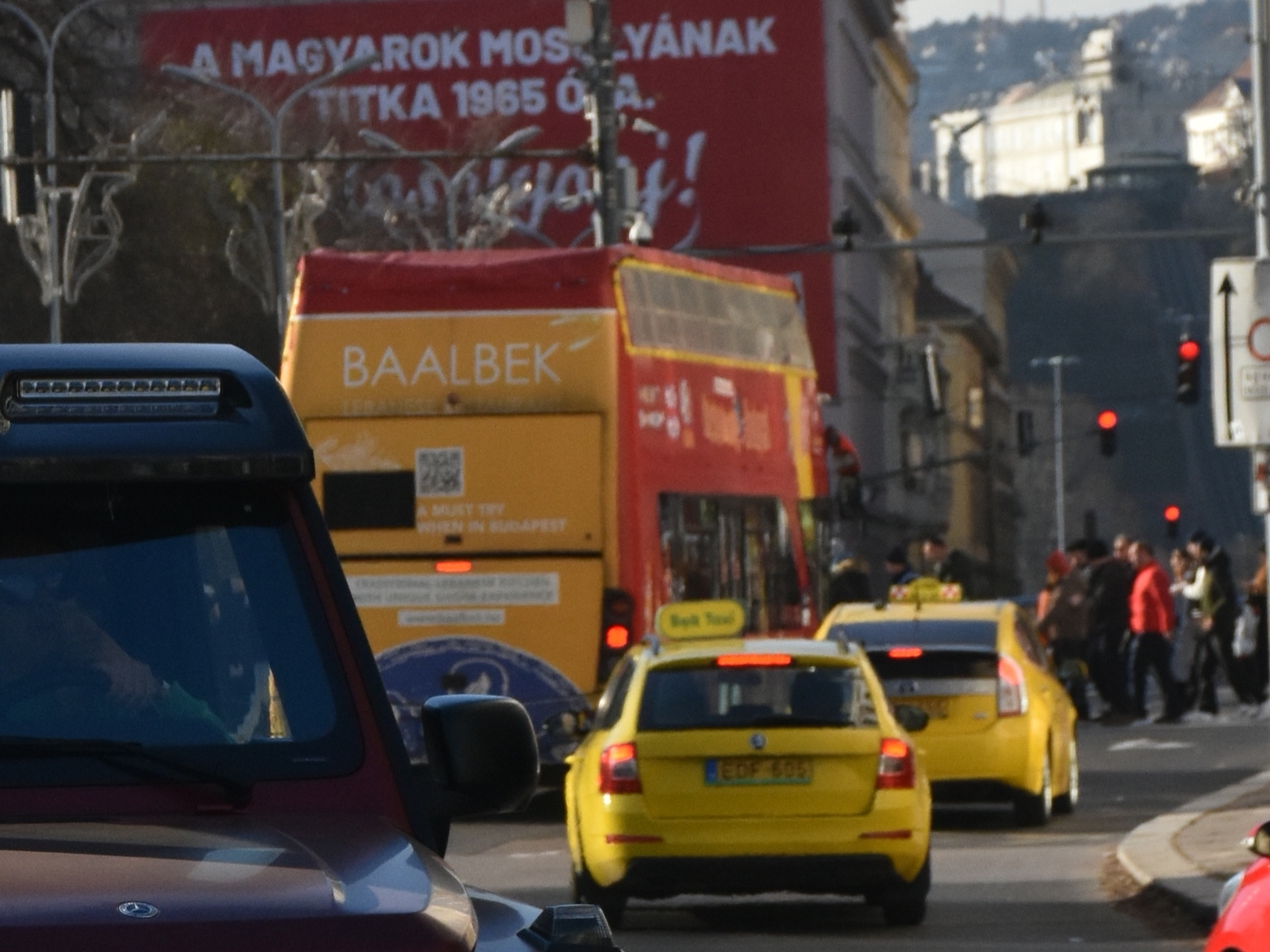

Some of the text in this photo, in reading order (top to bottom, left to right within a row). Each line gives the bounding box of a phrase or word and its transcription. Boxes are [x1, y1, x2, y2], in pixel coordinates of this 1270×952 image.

[191, 42, 221, 79] A
[232, 31, 470, 78] MAGYAROK
[309, 67, 656, 122] TITKA 1965 ÓA.
[342, 343, 561, 388] BAALBEK
[416, 503, 505, 517] A MUST TRY
[416, 517, 568, 534] WHEN IN BUDAPEST
